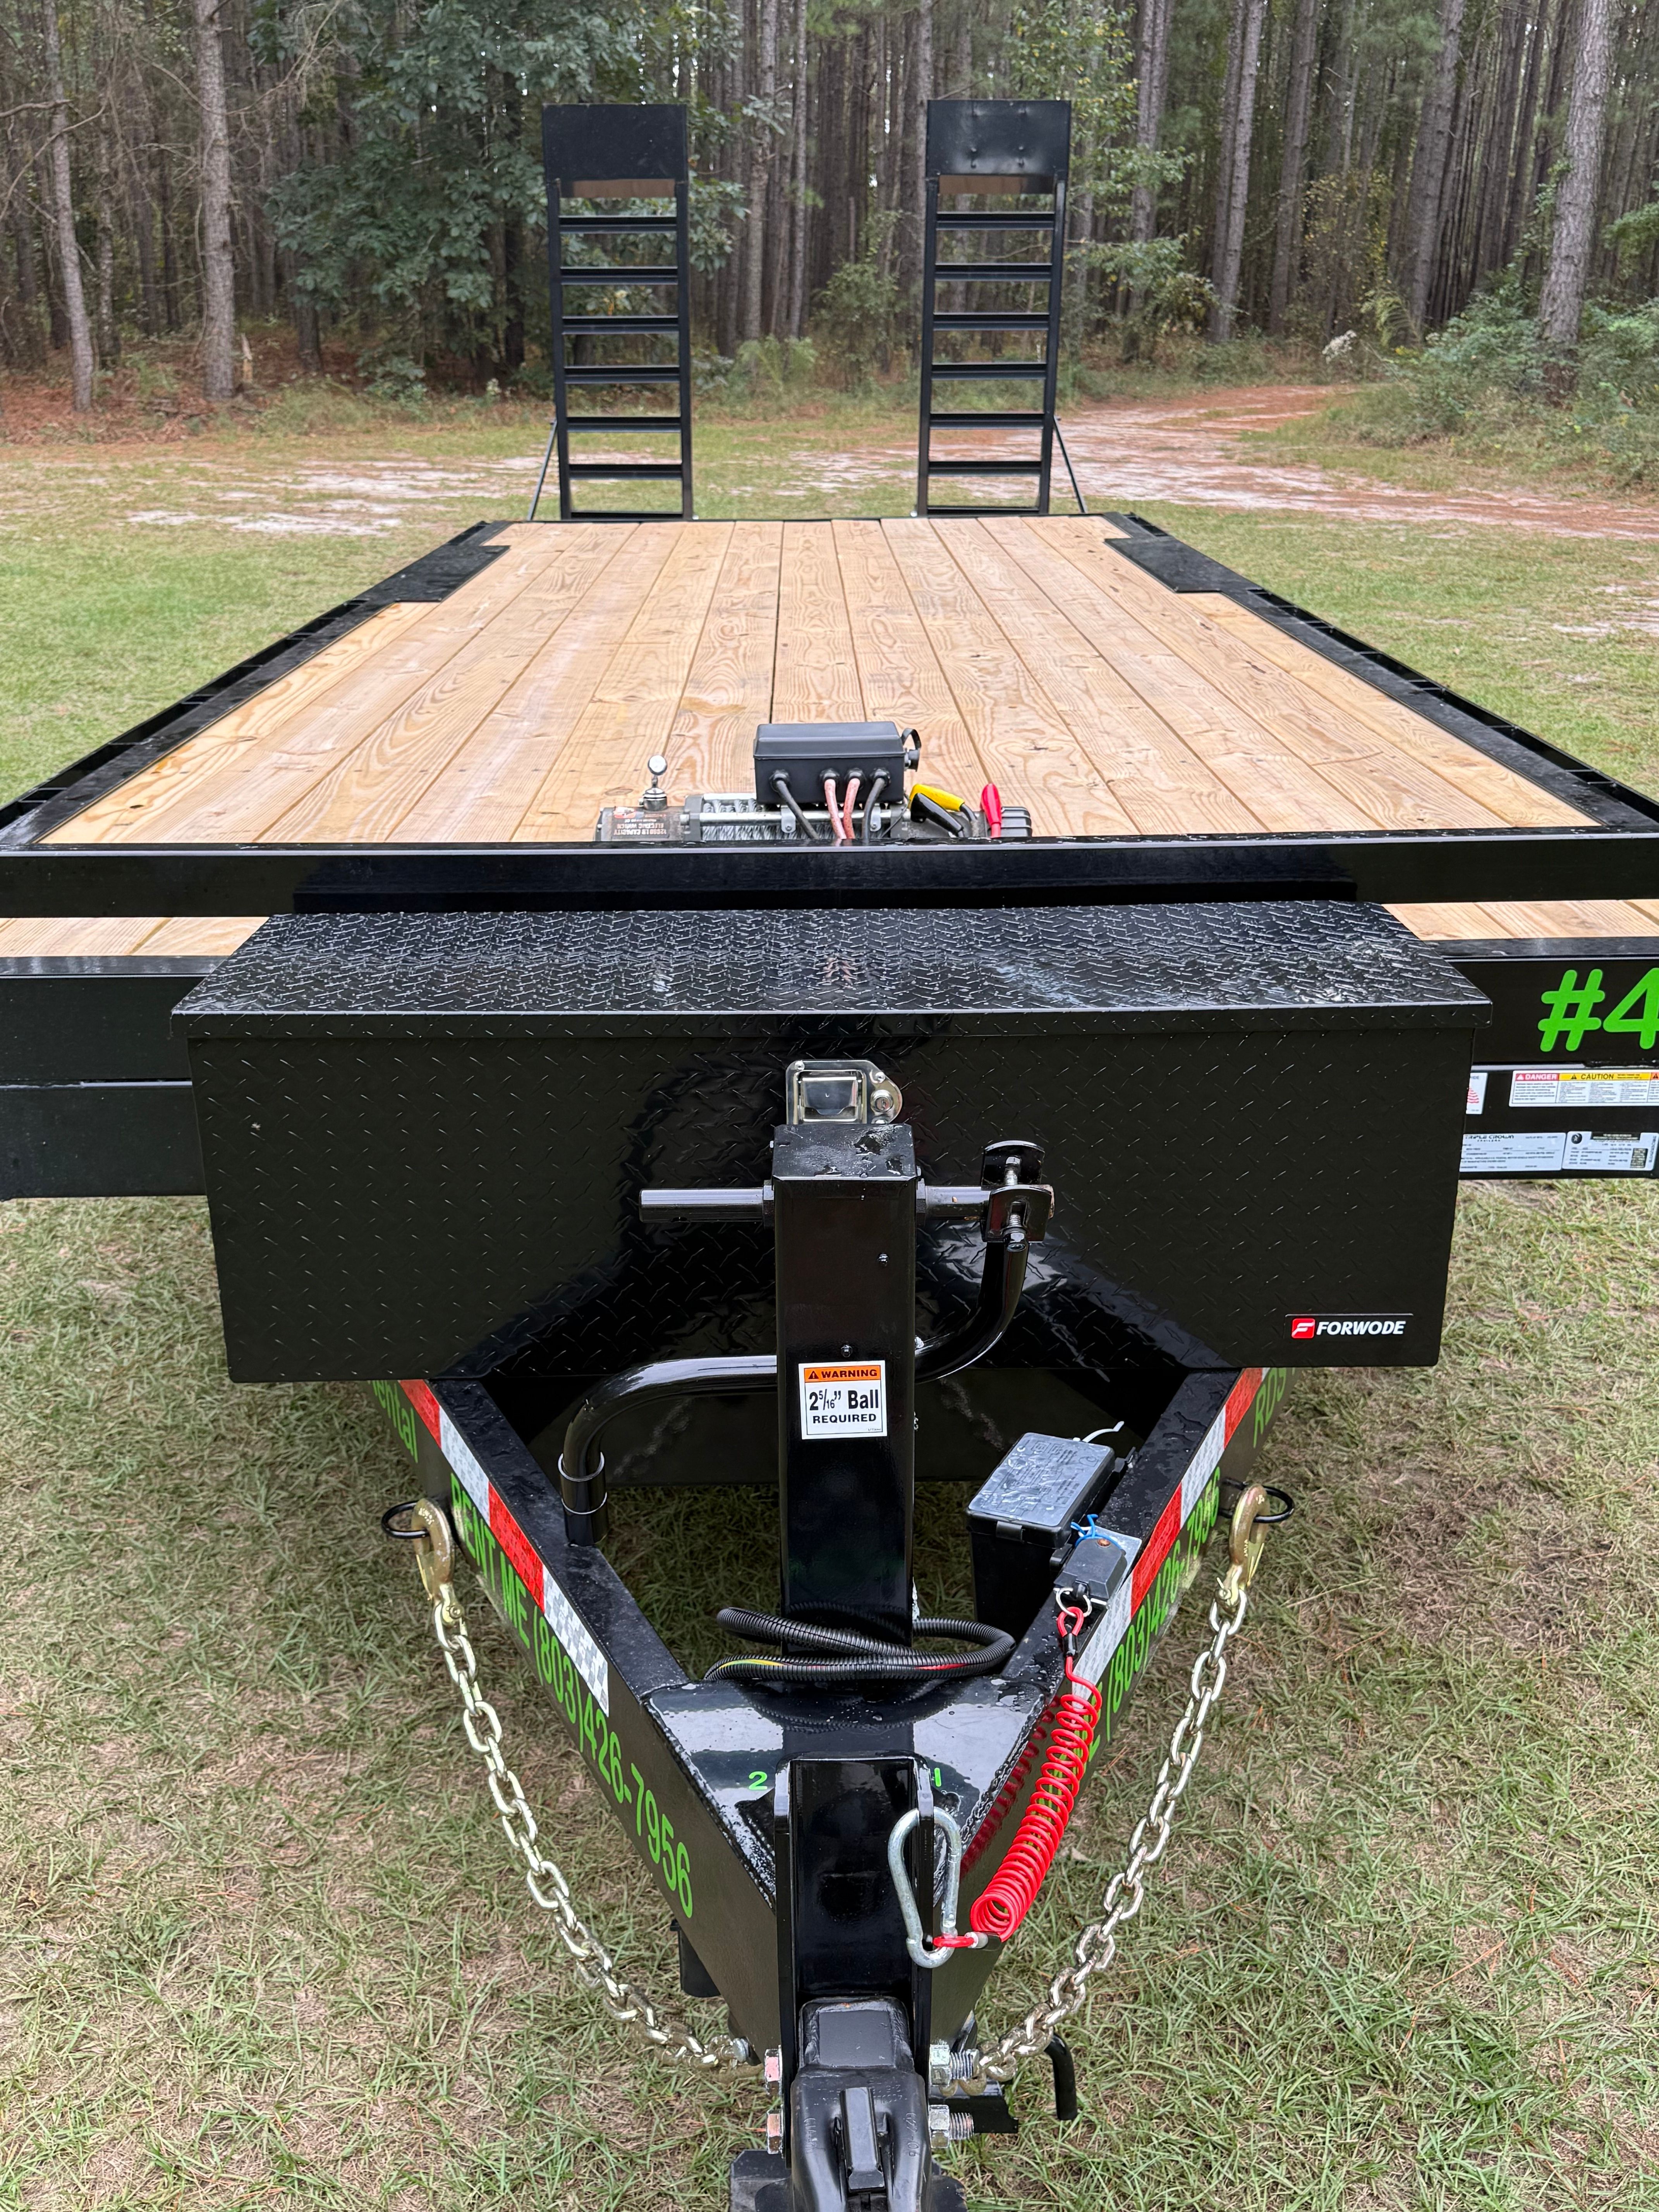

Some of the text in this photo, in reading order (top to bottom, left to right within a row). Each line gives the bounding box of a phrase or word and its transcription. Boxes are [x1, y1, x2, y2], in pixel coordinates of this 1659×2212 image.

[1538, 968, 1659, 1052] #4
[1317, 1321, 1406, 1335] FORWODE
[821, 1369, 878, 1378] WARNING
[848, 1389, 879, 1409] Ball
[368, 1380, 418, 1463] ental
[812, 1413, 877, 1424] REQUIRED
[1106, 1466, 1221, 1742] (803)426-7956
[450, 1472, 693, 1918] RENT ME (803)426-7956
[748, 1771, 768, 1790] 2
